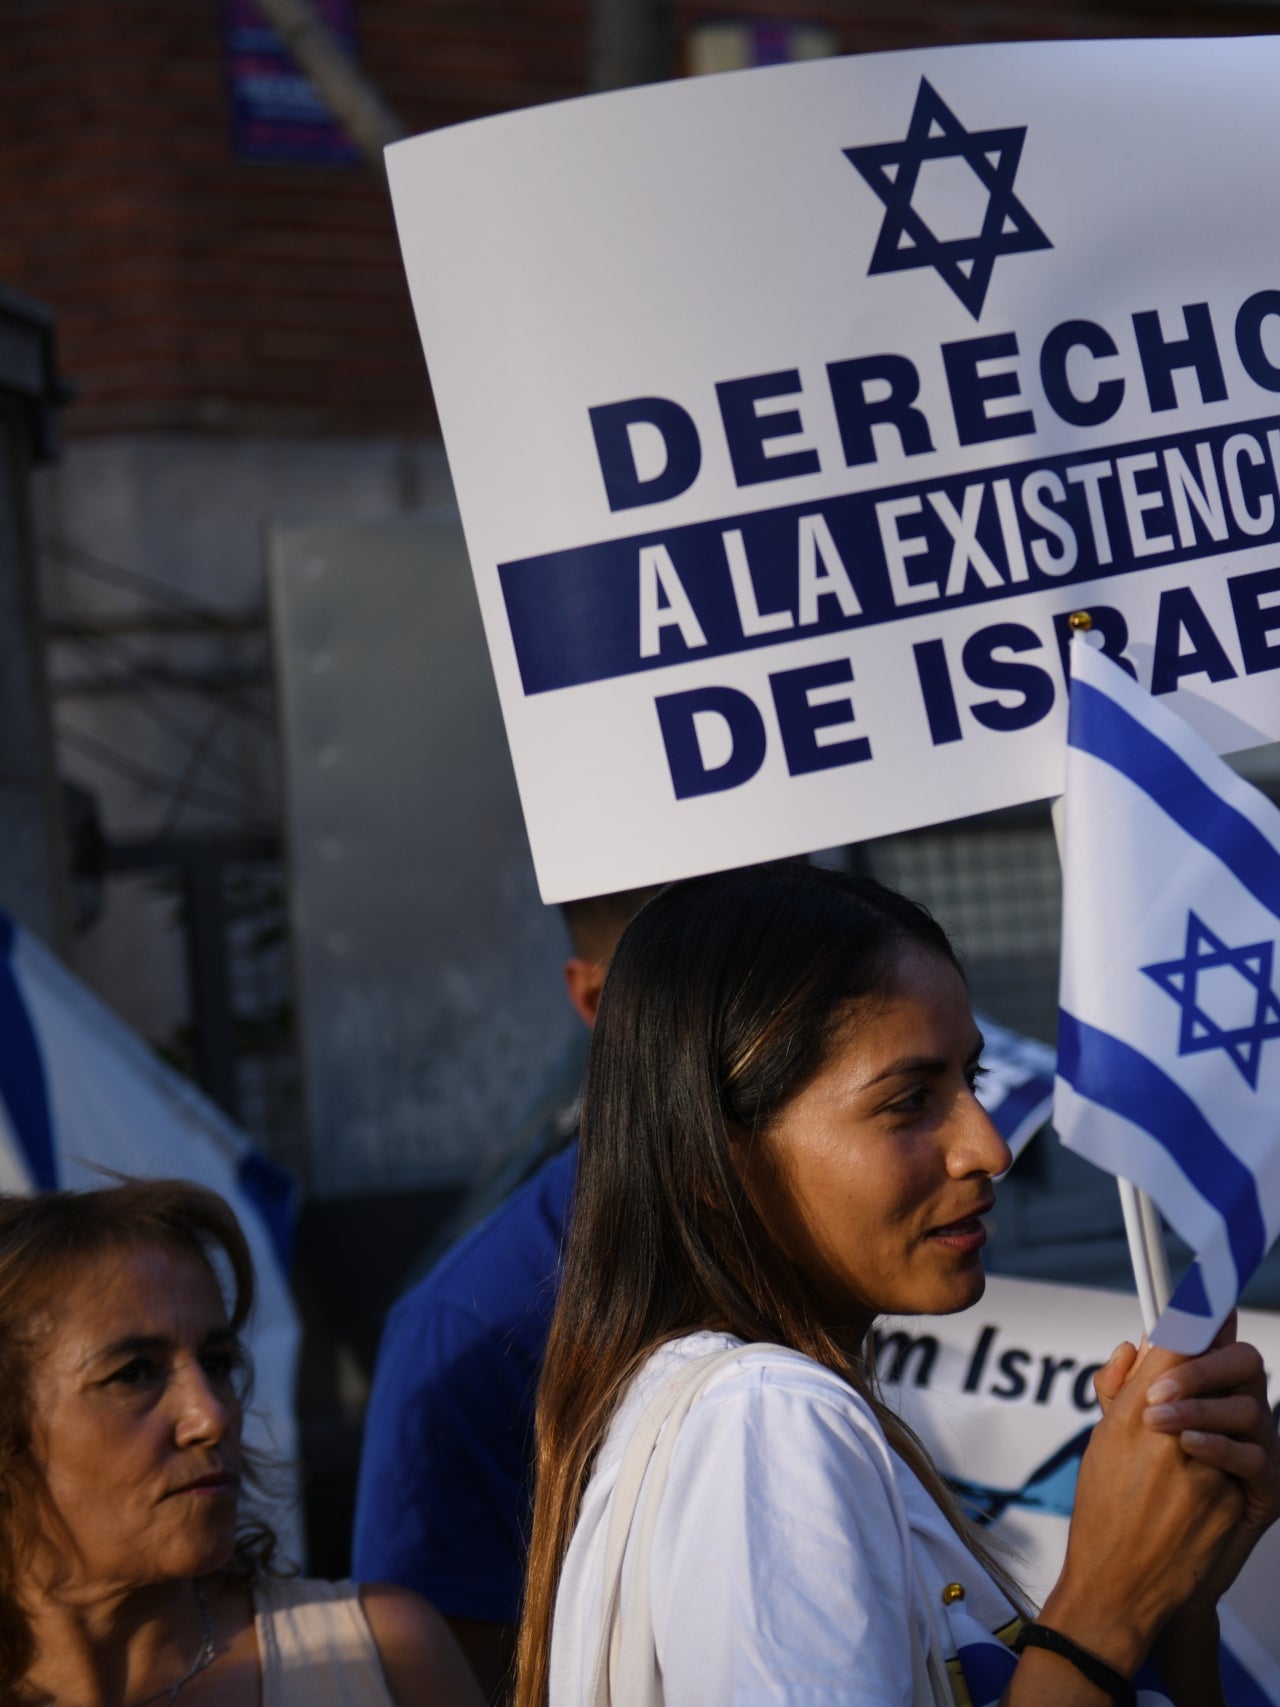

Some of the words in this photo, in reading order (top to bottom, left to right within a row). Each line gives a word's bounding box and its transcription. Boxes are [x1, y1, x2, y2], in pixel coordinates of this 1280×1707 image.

[638, 543, 708, 659] A
[721, 512, 863, 639] LA
[653, 657, 874, 802] DE
